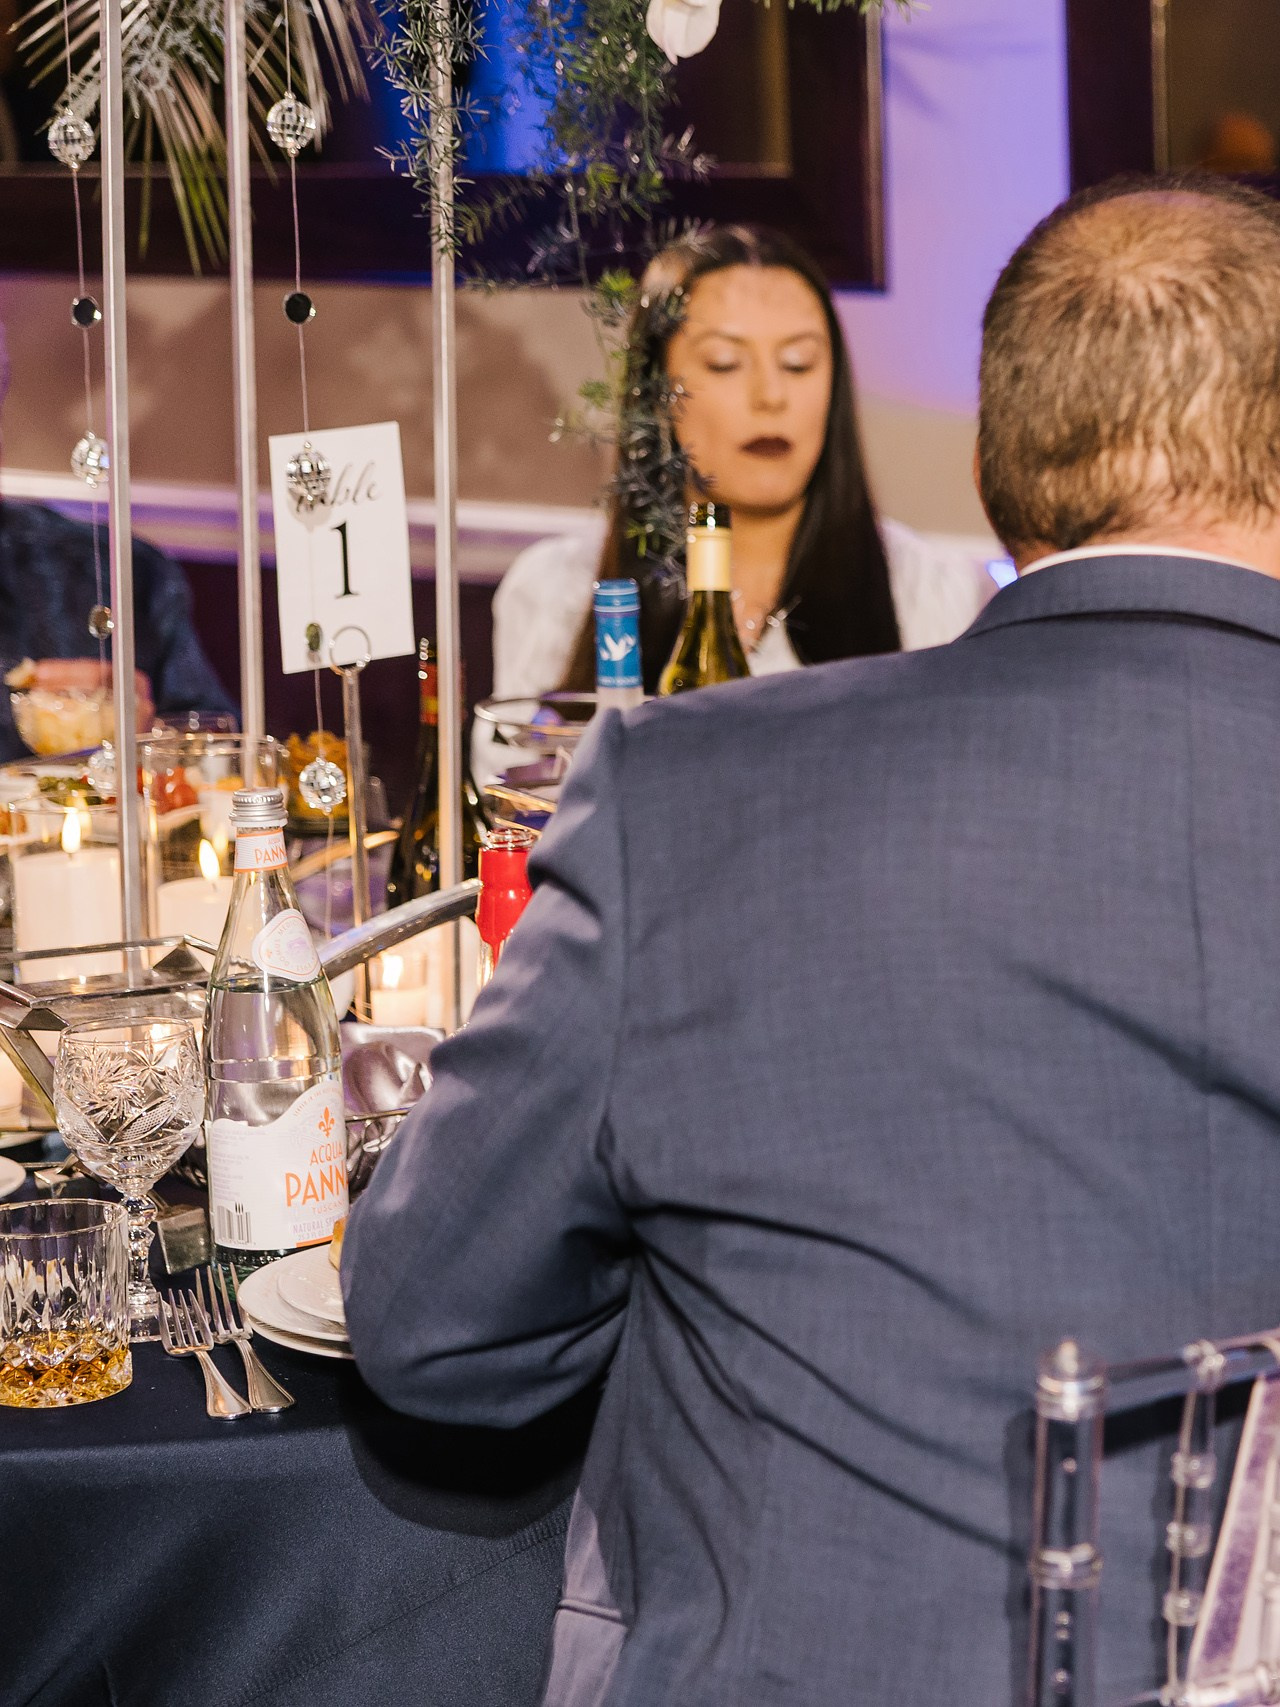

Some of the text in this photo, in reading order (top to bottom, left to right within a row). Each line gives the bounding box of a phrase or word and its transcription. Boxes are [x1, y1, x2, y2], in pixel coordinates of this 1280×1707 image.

[332, 521, 359, 599] 1
[254, 845, 288, 865] PANN
[310, 1142, 343, 1165] ACQUA
[285, 1160, 349, 1207] PANN
[311, 1199, 344, 1214] TUSCAN
